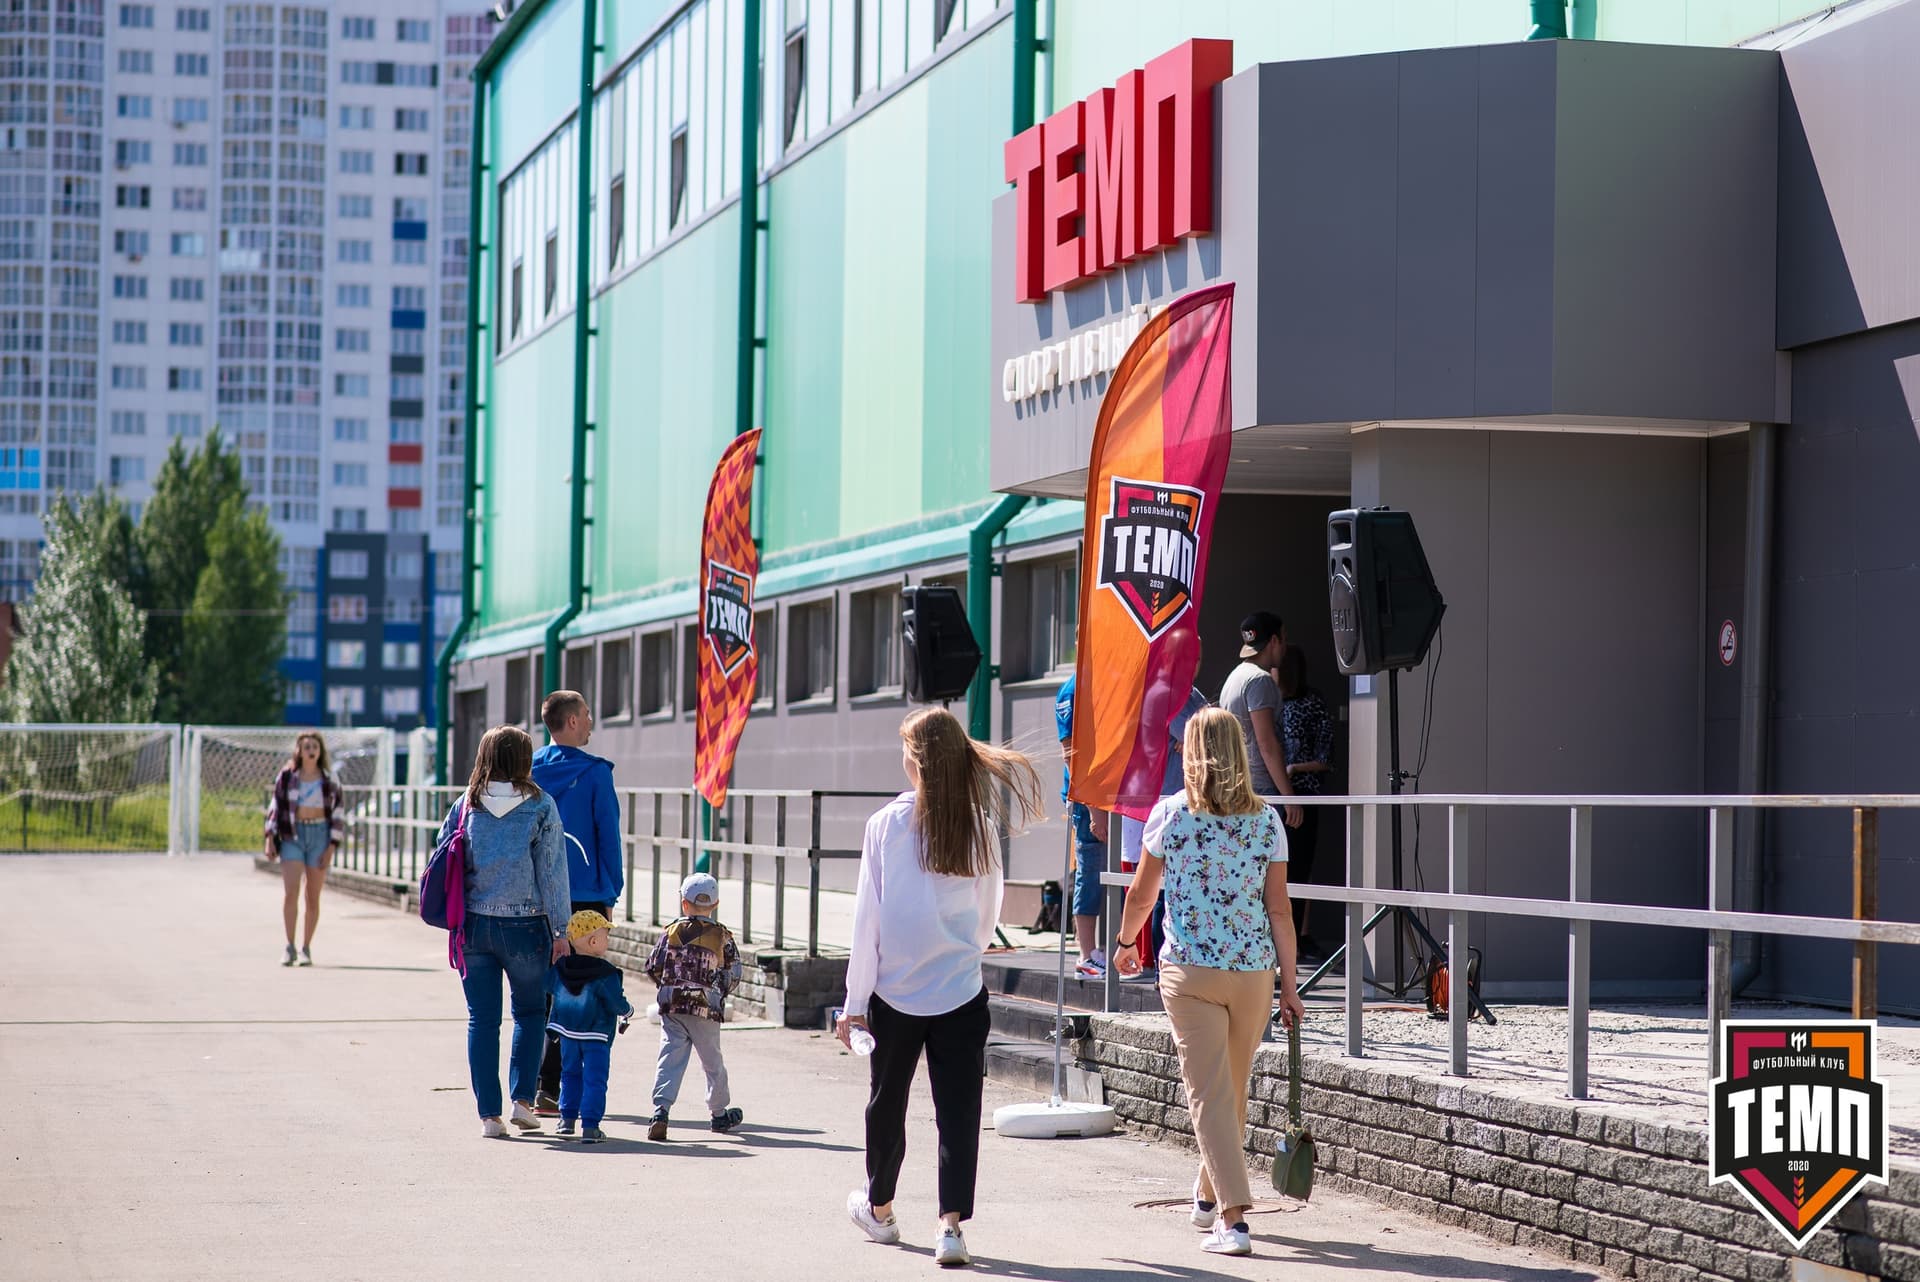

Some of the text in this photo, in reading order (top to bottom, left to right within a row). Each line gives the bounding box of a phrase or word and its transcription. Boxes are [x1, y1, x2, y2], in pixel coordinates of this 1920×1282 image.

[1004, 38, 1233, 304] ТЕМП
[1130, 505, 1175, 518] ФУТБОЛЬНЫЙ
[1113, 525, 1194, 588] ТЕМП
[1149, 579, 1165, 590] 2020
[709, 595, 749, 643] ТЕМП
